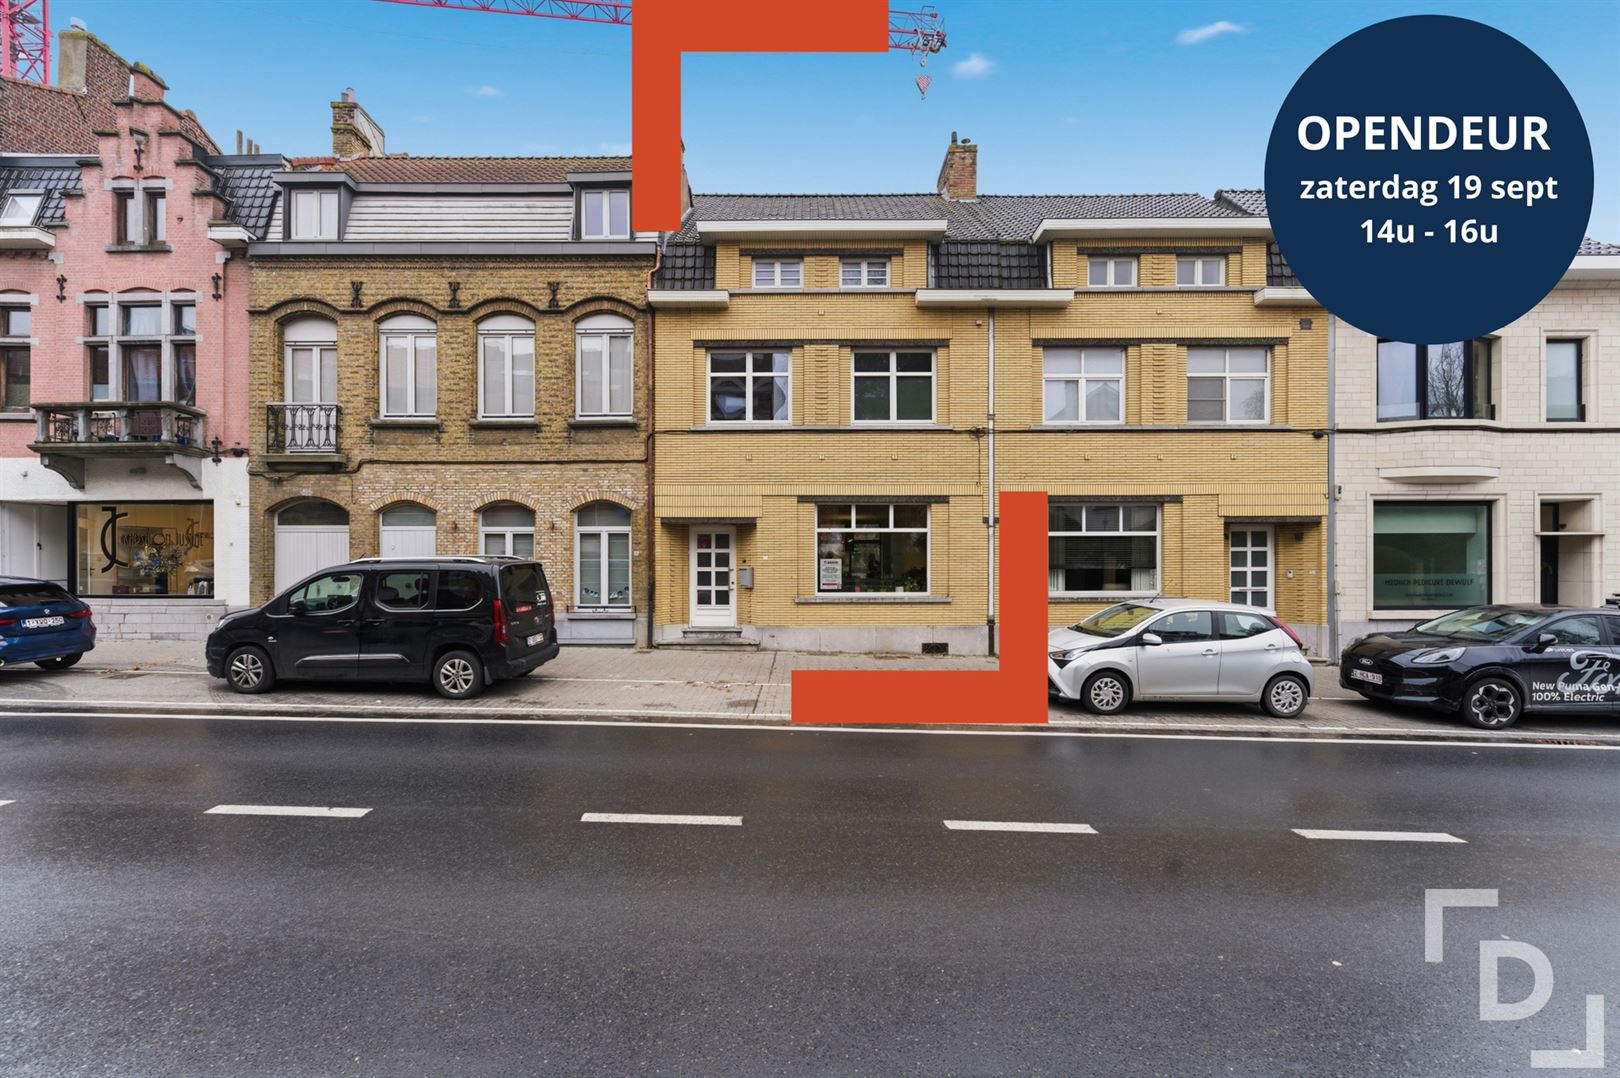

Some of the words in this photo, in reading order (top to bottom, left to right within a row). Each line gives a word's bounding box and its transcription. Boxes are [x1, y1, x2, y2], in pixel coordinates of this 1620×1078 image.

[1532, 681, 1555, 691] New
[1559, 681, 1590, 692] Puma
[1594, 681, 1620, 692] Gen-
[1532, 692, 1560, 702] 100%
[1563, 692, 1605, 702] Electric
